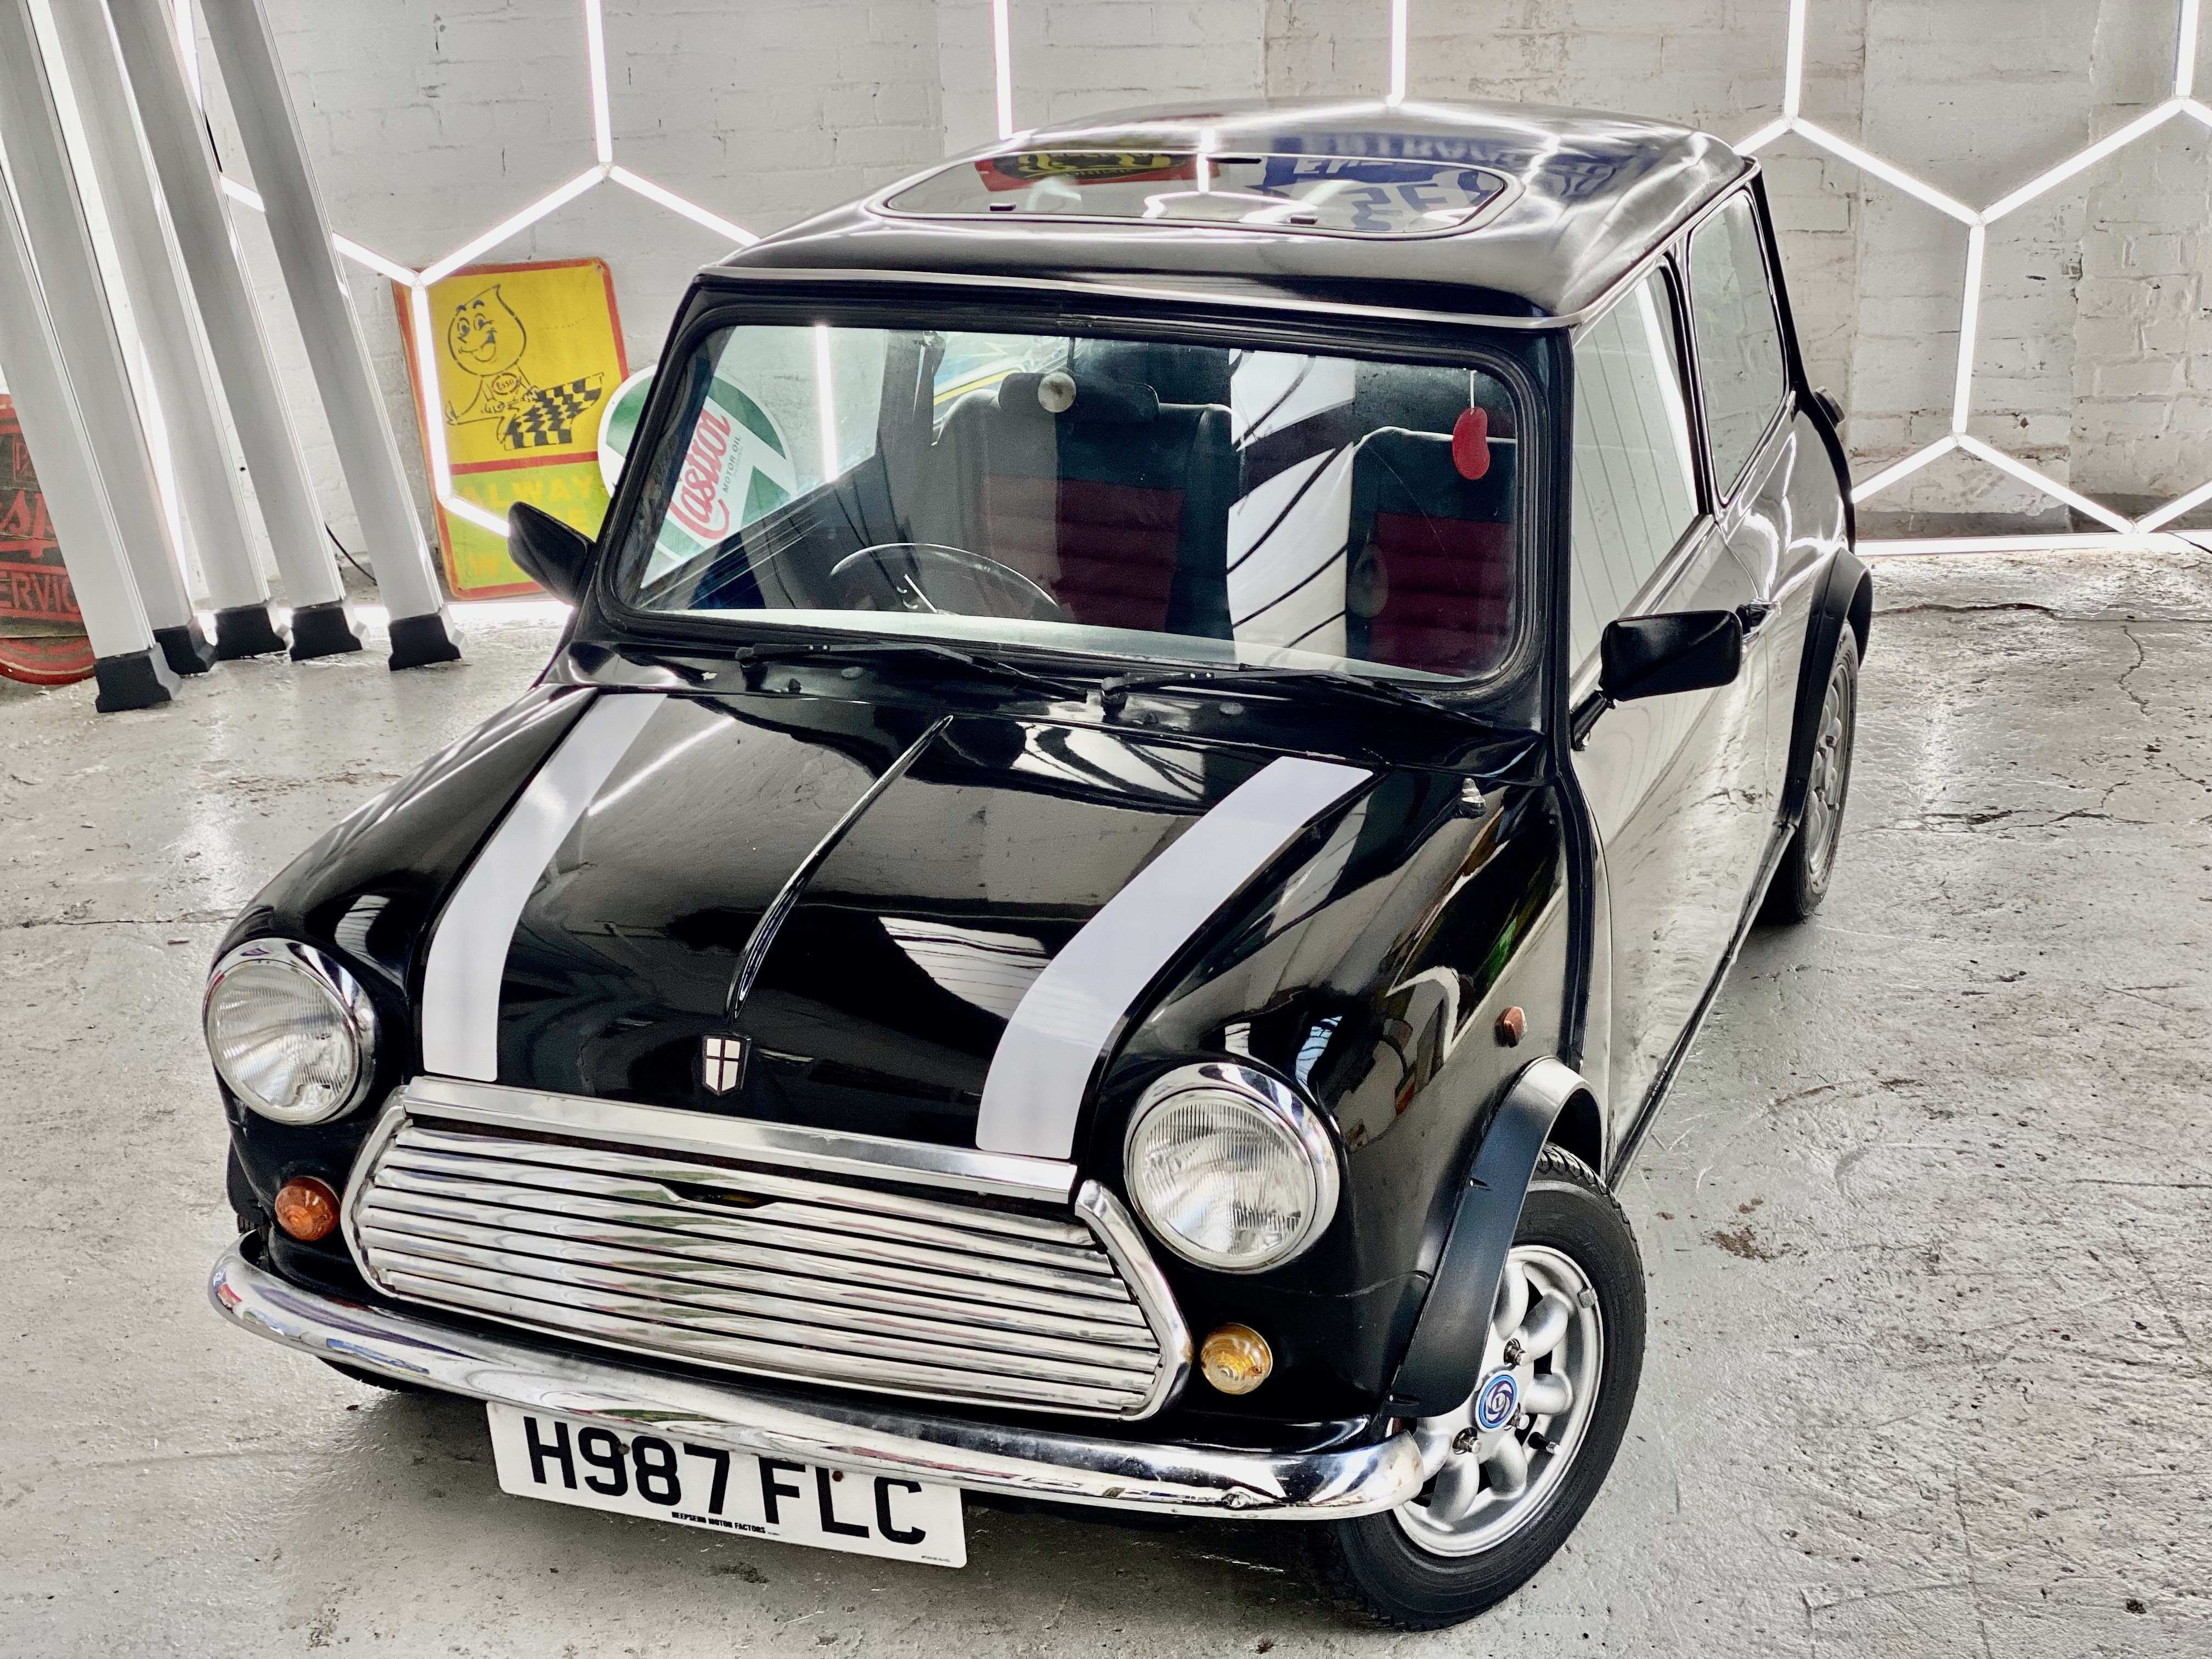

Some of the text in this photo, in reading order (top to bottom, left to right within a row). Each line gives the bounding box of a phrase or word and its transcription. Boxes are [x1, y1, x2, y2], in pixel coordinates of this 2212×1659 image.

[460, 475, 606, 507] ALWAY
[669, 408, 731, 539] Castrol
[723, 436, 741, 493] MOTOR OIL
[523, 1416, 926, 1545] H987 FLC
[708, 1518, 733, 1528] MOTOR
[734, 1522, 766, 1534] FACTORS
